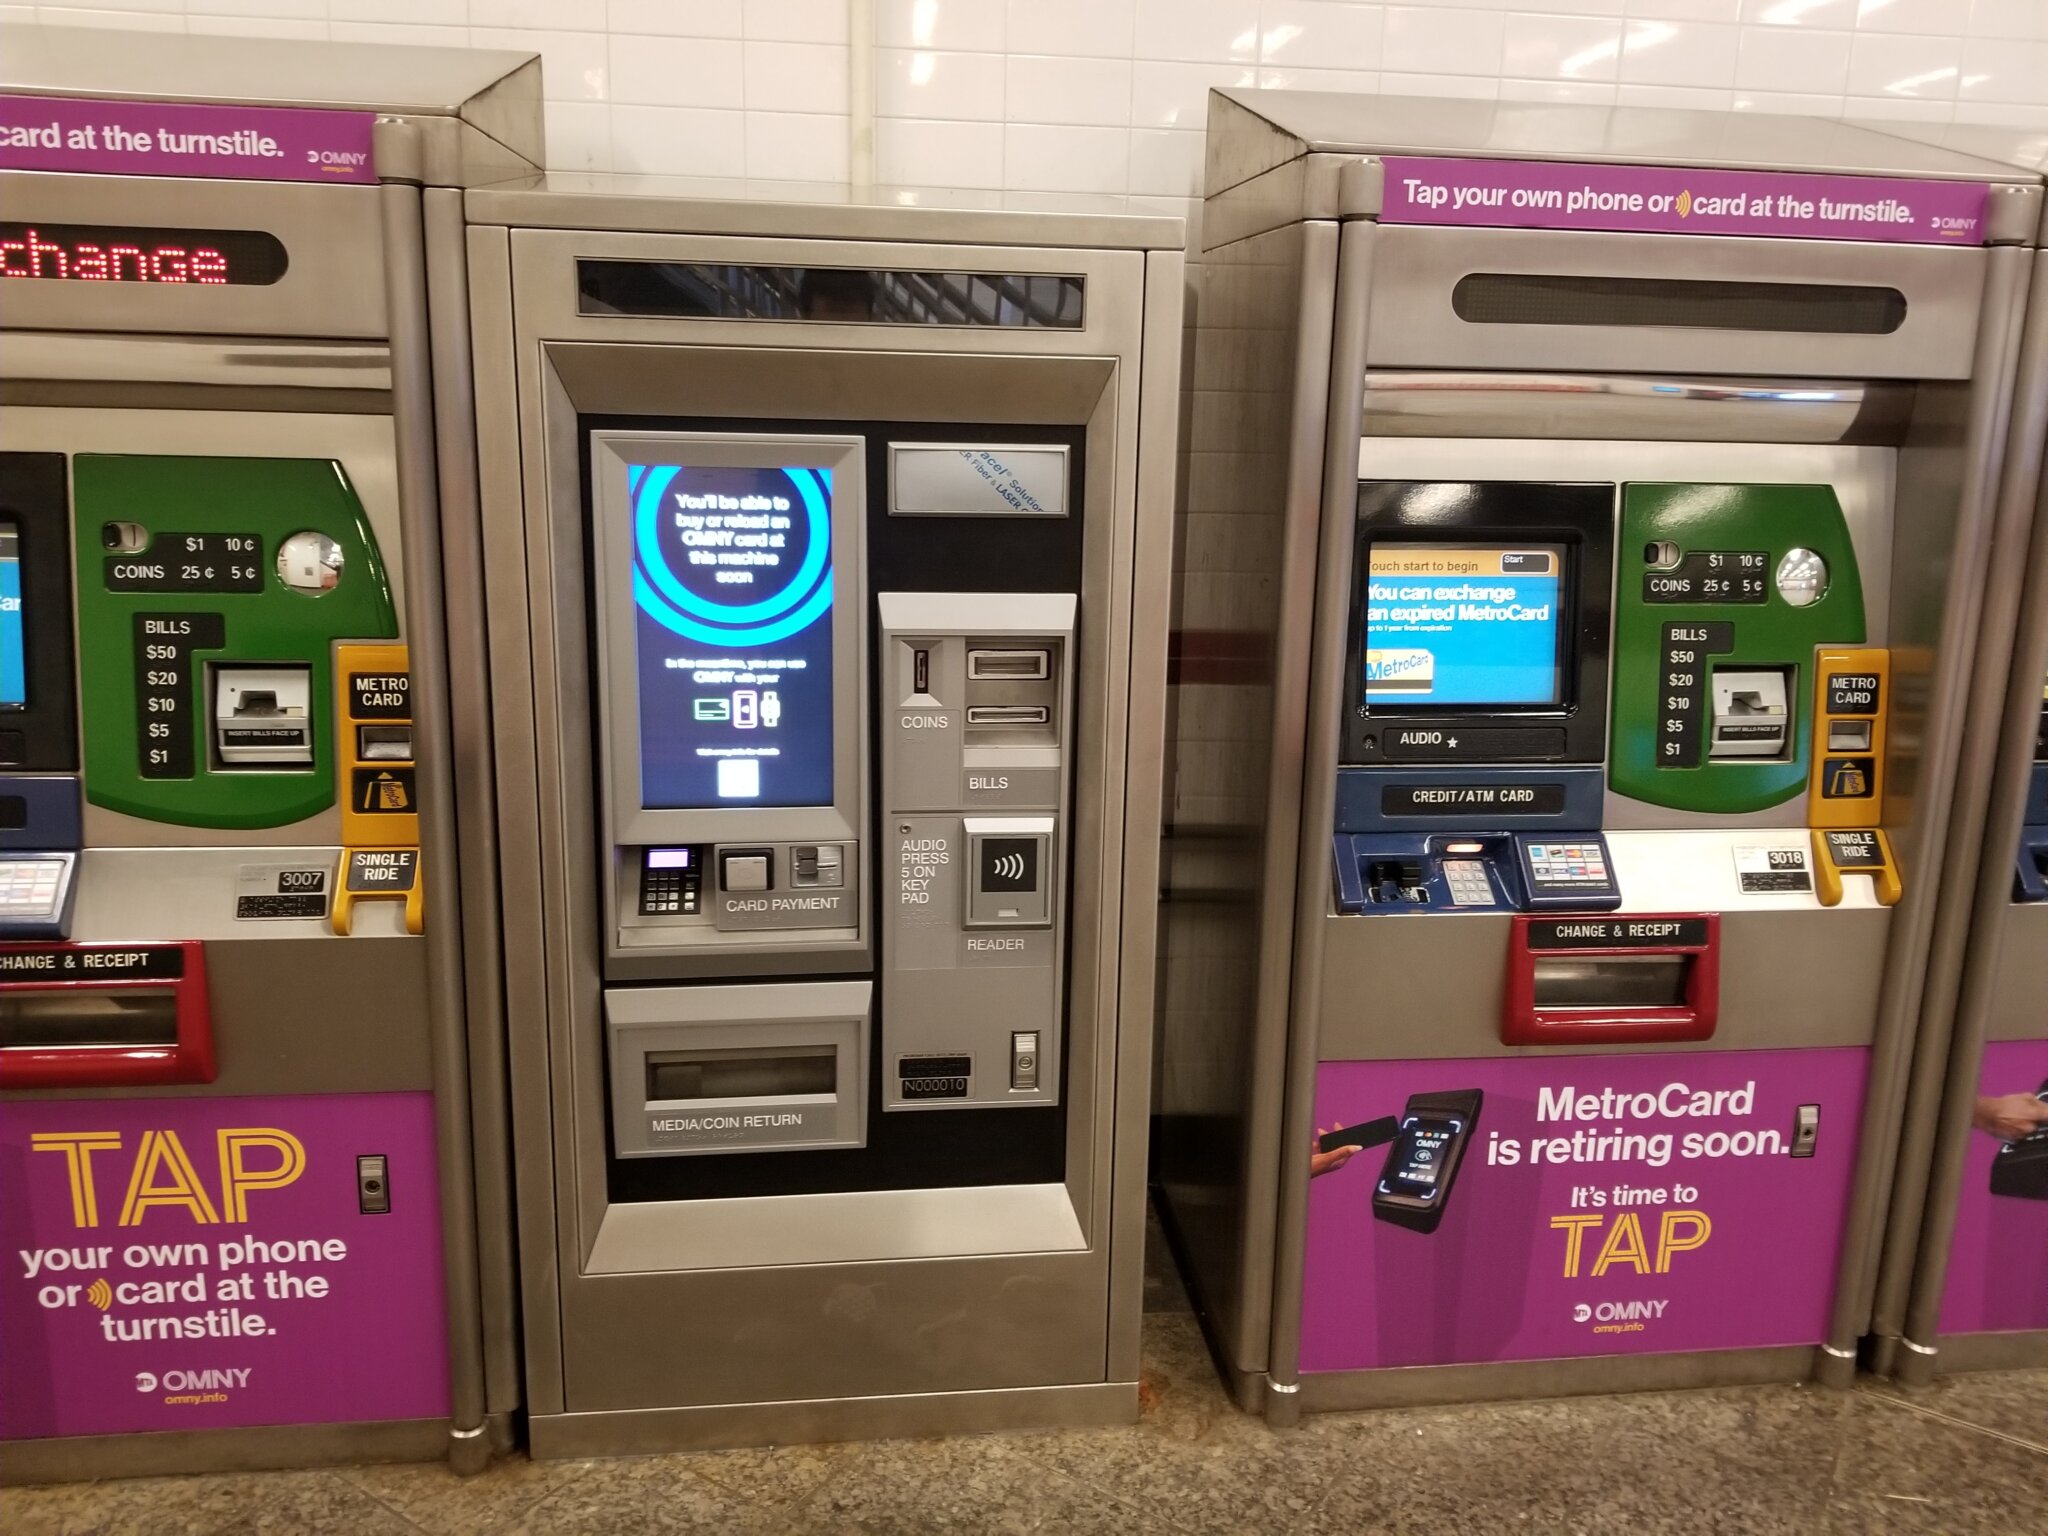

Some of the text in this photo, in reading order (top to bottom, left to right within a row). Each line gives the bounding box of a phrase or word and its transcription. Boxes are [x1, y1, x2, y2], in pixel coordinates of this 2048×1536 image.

[67, 125, 97, 150] at
[102, 125, 152, 153] the
[157, 128, 284, 158] turnstile.
[321, 150, 367, 166] OMNY
[1403, 178, 1915, 224] Tap your own phone or card at the turnstile.
[0, 230, 227, 284] change
[970, 459, 993, 480] Fiber
[995, 484, 1022, 510] LASER
[773, 496, 790, 511] to
[185, 538, 204, 551] $1
[734, 532, 768, 547] card
[769, 533, 786, 547] at
[1369, 560, 1479, 573] ouch start to begin
[1504, 555, 1524, 564] Start
[1709, 555, 1723, 567] $1
[114, 565, 165, 579] COINS
[715, 570, 754, 584] soon
[1650, 580, 1691, 592] COINS
[1368, 584, 1516, 603] You can exchange
[0, 597, 21, 611] ar
[1368, 604, 1549, 624] an expired MetroCard
[145, 621, 191, 634] BILLS
[1670, 629, 1708, 641] BILLS
[146, 645, 177, 660] $50
[1670, 651, 1694, 664] $50
[147, 671, 178, 686] $20
[356, 677, 409, 691] METRO
[1669, 674, 1694, 687] $20
[1832, 678, 1876, 690] METRO
[148, 698, 175, 712] $10
[362, 693, 403, 706] CARD
[1667, 697, 1690, 710] $10
[1835, 692, 1871, 704] CARD
[901, 716, 948, 729] COINS
[1666, 720, 1684, 733] $5
[149, 724, 170, 738] $5
[1400, 732, 1442, 745] AUDIO
[1665, 742, 1681, 756] $1
[150, 750, 168, 764] $1
[969, 777, 1008, 789] BILLS
[1412, 790, 1534, 803] CREDIT/ATM CARD
[902, 839, 947, 851] AUDIO
[1831, 833, 1875, 845] SINGLE
[901, 852, 950, 864] PRESS
[1770, 852, 1803, 864] 3018
[1842, 846, 1871, 857] RIDE
[357, 853, 410, 866] SINGLE
[281, 872, 322, 886] 3007
[364, 867, 399, 881] RIDE
[901, 866, 936, 878] 5 ON
[901, 879, 930, 891] KEY
[726, 897, 840, 912] CARD PAYMENT
[901, 892, 930, 904] PAD
[1556, 924, 1681, 937] CHANGE & RECEIPT
[967, 939, 1025, 950] READER
[64, 955, 76, 969] &
[83, 953, 149, 968] RECEIPT
[905, 1079, 965, 1092] N000010
[1537, 1081, 1755, 1121] MetroCard
[652, 1113, 802, 1132] MEDIA/COIN RETURN
[1488, 1128, 1790, 1167] is retiring soon.
[31, 1127, 306, 1228] TAP
[1571, 1184, 1699, 1207] It's time to
[1550, 1210, 1712, 1278] TAP
[19, 1234, 347, 1278] your own phone
[38, 1270, 330, 1309] or card at the
[1595, 1300, 1669, 1321] OMNY
[100, 1307, 277, 1342] turnstile.
[1593, 1322, 1645, 1334] omny.info
[162, 1368, 252, 1391] OMNY
[164, 1393, 229, 1405] omny.info
